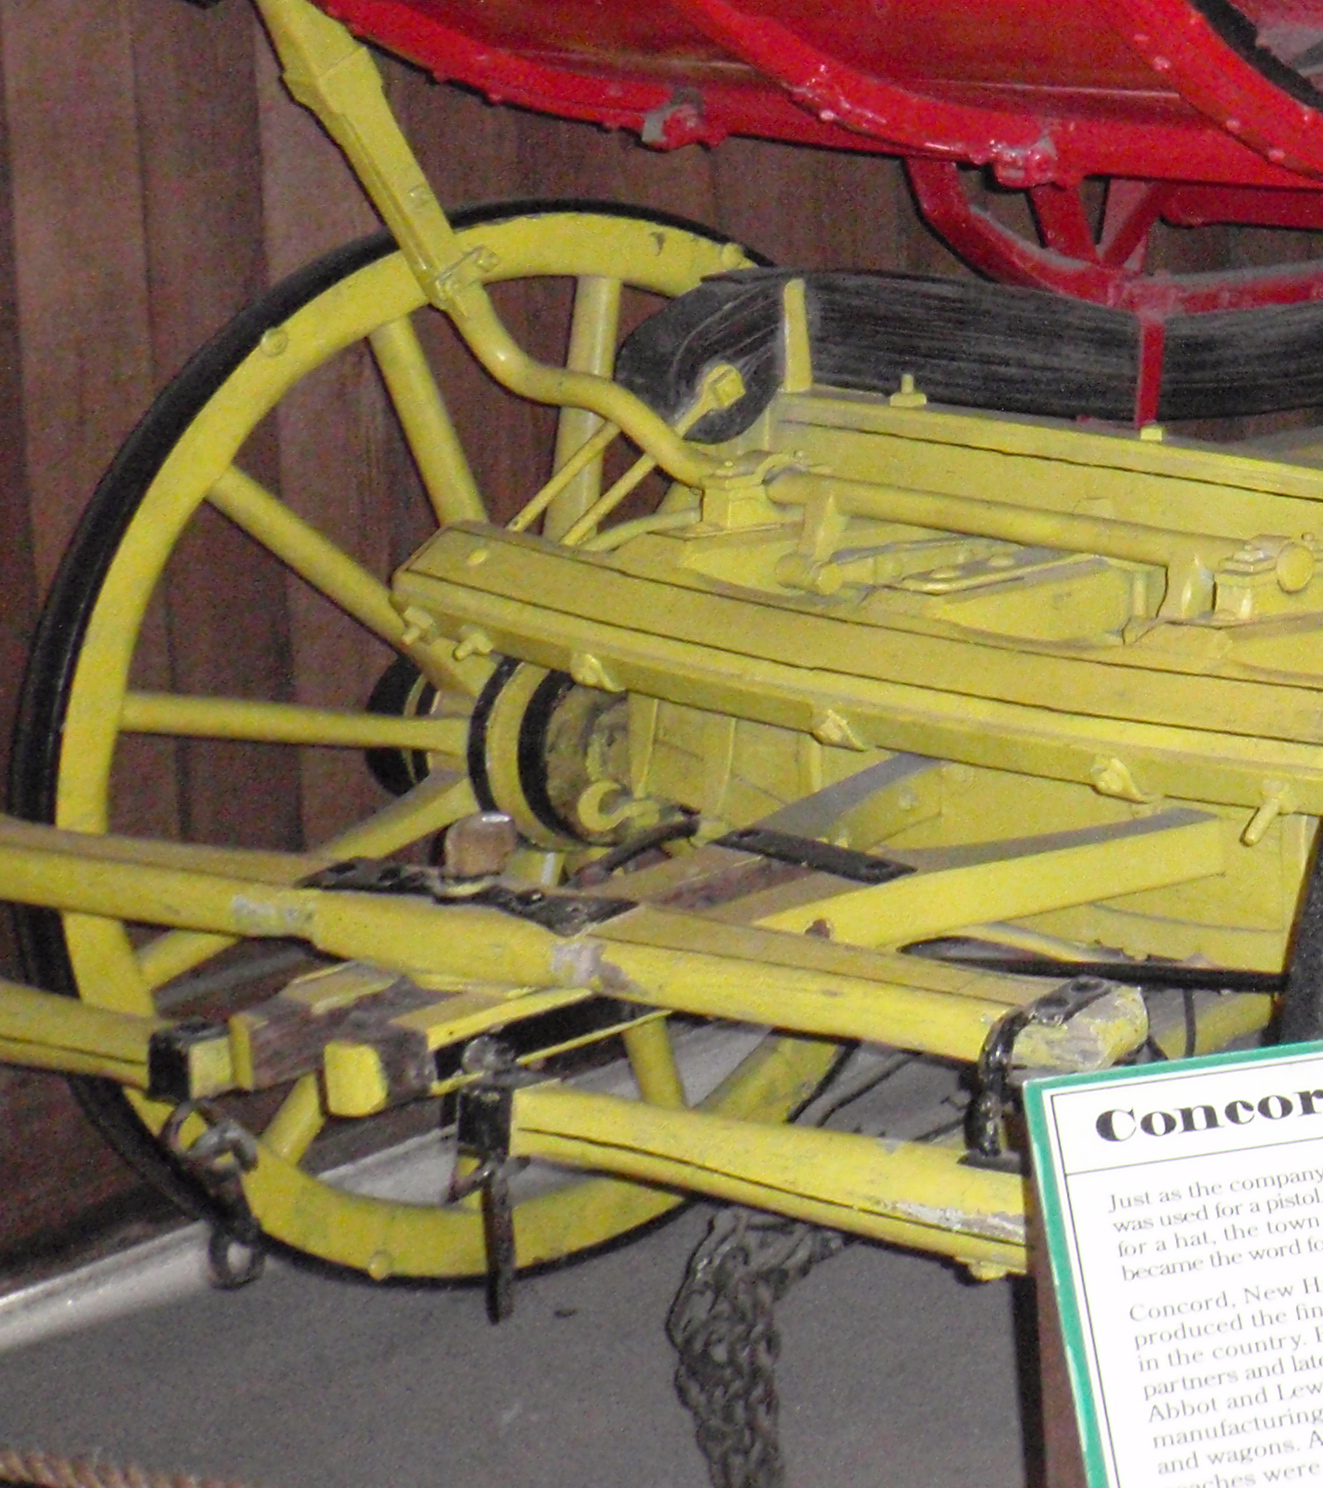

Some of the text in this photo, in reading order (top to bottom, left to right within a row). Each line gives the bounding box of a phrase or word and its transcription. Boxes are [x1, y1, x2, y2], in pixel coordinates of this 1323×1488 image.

[1108, 1191, 1151, 1214] Just
[1159, 1190, 1182, 1203] as
[1188, 1181, 1222, 1199] the
[1112, 1218, 1154, 1233] was
[1159, 1204, 1209, 1227] used
[1214, 1202, 1243, 1219] for
[1249, 1202, 1261, 1213] a
[1117, 1240, 1147, 1258] for
[1155, 1240, 1167, 1252] a
[1223, 1223, 1258, 1241] the
[1266, 1216, 1320, 1235] town
[1121, 1259, 1204, 1281] became
[1209, 1250, 1243, 1268] the
[1247, 1238, 1302, 1261] word
[1243, 1285, 1294, 1304] New
[1134, 1313, 1243, 1351] produced
[1251, 1309, 1287, 1328] the
[1138, 1355, 1159, 1372] in
[1167, 1348, 1204, 1367] the
[1143, 1371, 1239, 1402] partners
[1245, 1357, 1285, 1381] and
[1148, 1397, 1218, 1423] Abbot
[1227, 1386, 1268, 1409] and
[1158, 1450, 1199, 1475] and
[1263, 1463, 1320, 1482] were
